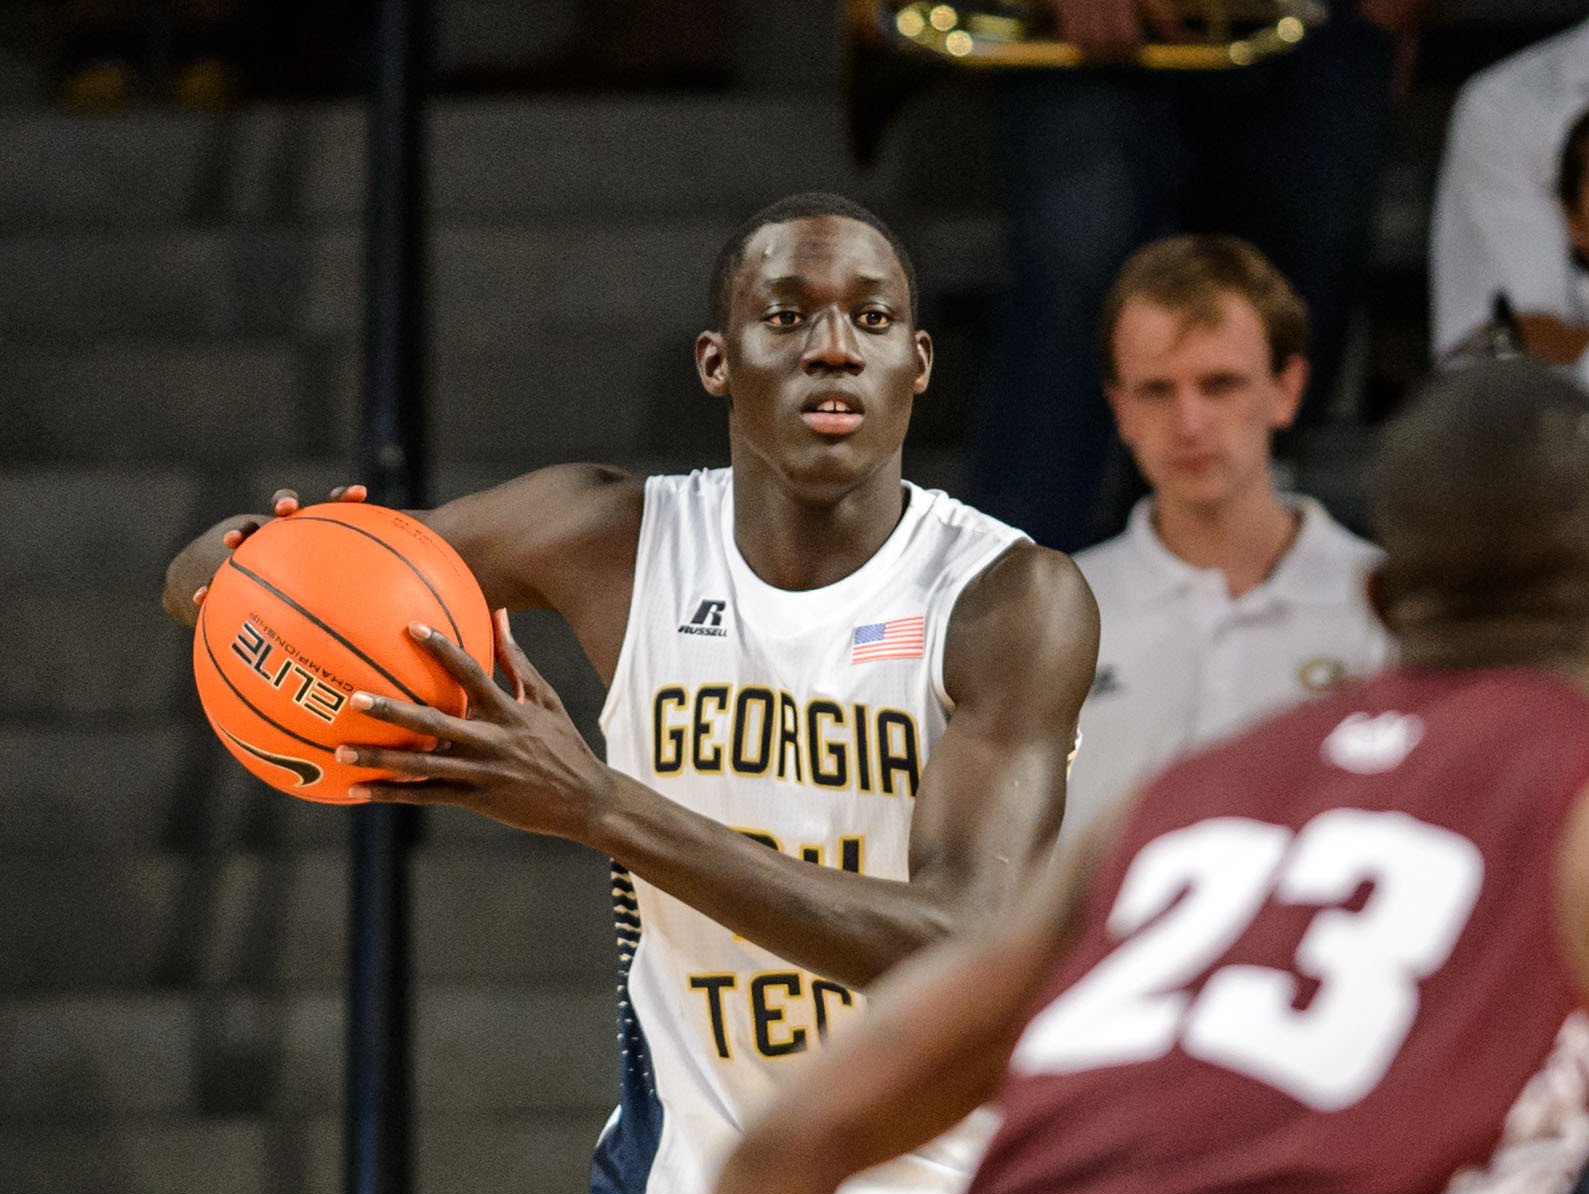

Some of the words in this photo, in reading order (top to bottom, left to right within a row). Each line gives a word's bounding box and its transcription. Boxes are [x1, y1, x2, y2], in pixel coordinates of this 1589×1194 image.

[231, 620, 348, 723] ELITE
[250, 611, 354, 692] CHAMPIONSHIP
[678, 625, 728, 637] RUSSELL
[652, 682, 922, 798] GEORGIA
[1011, 806, 1485, 1112] 23
[686, 968, 868, 1061] TEC
